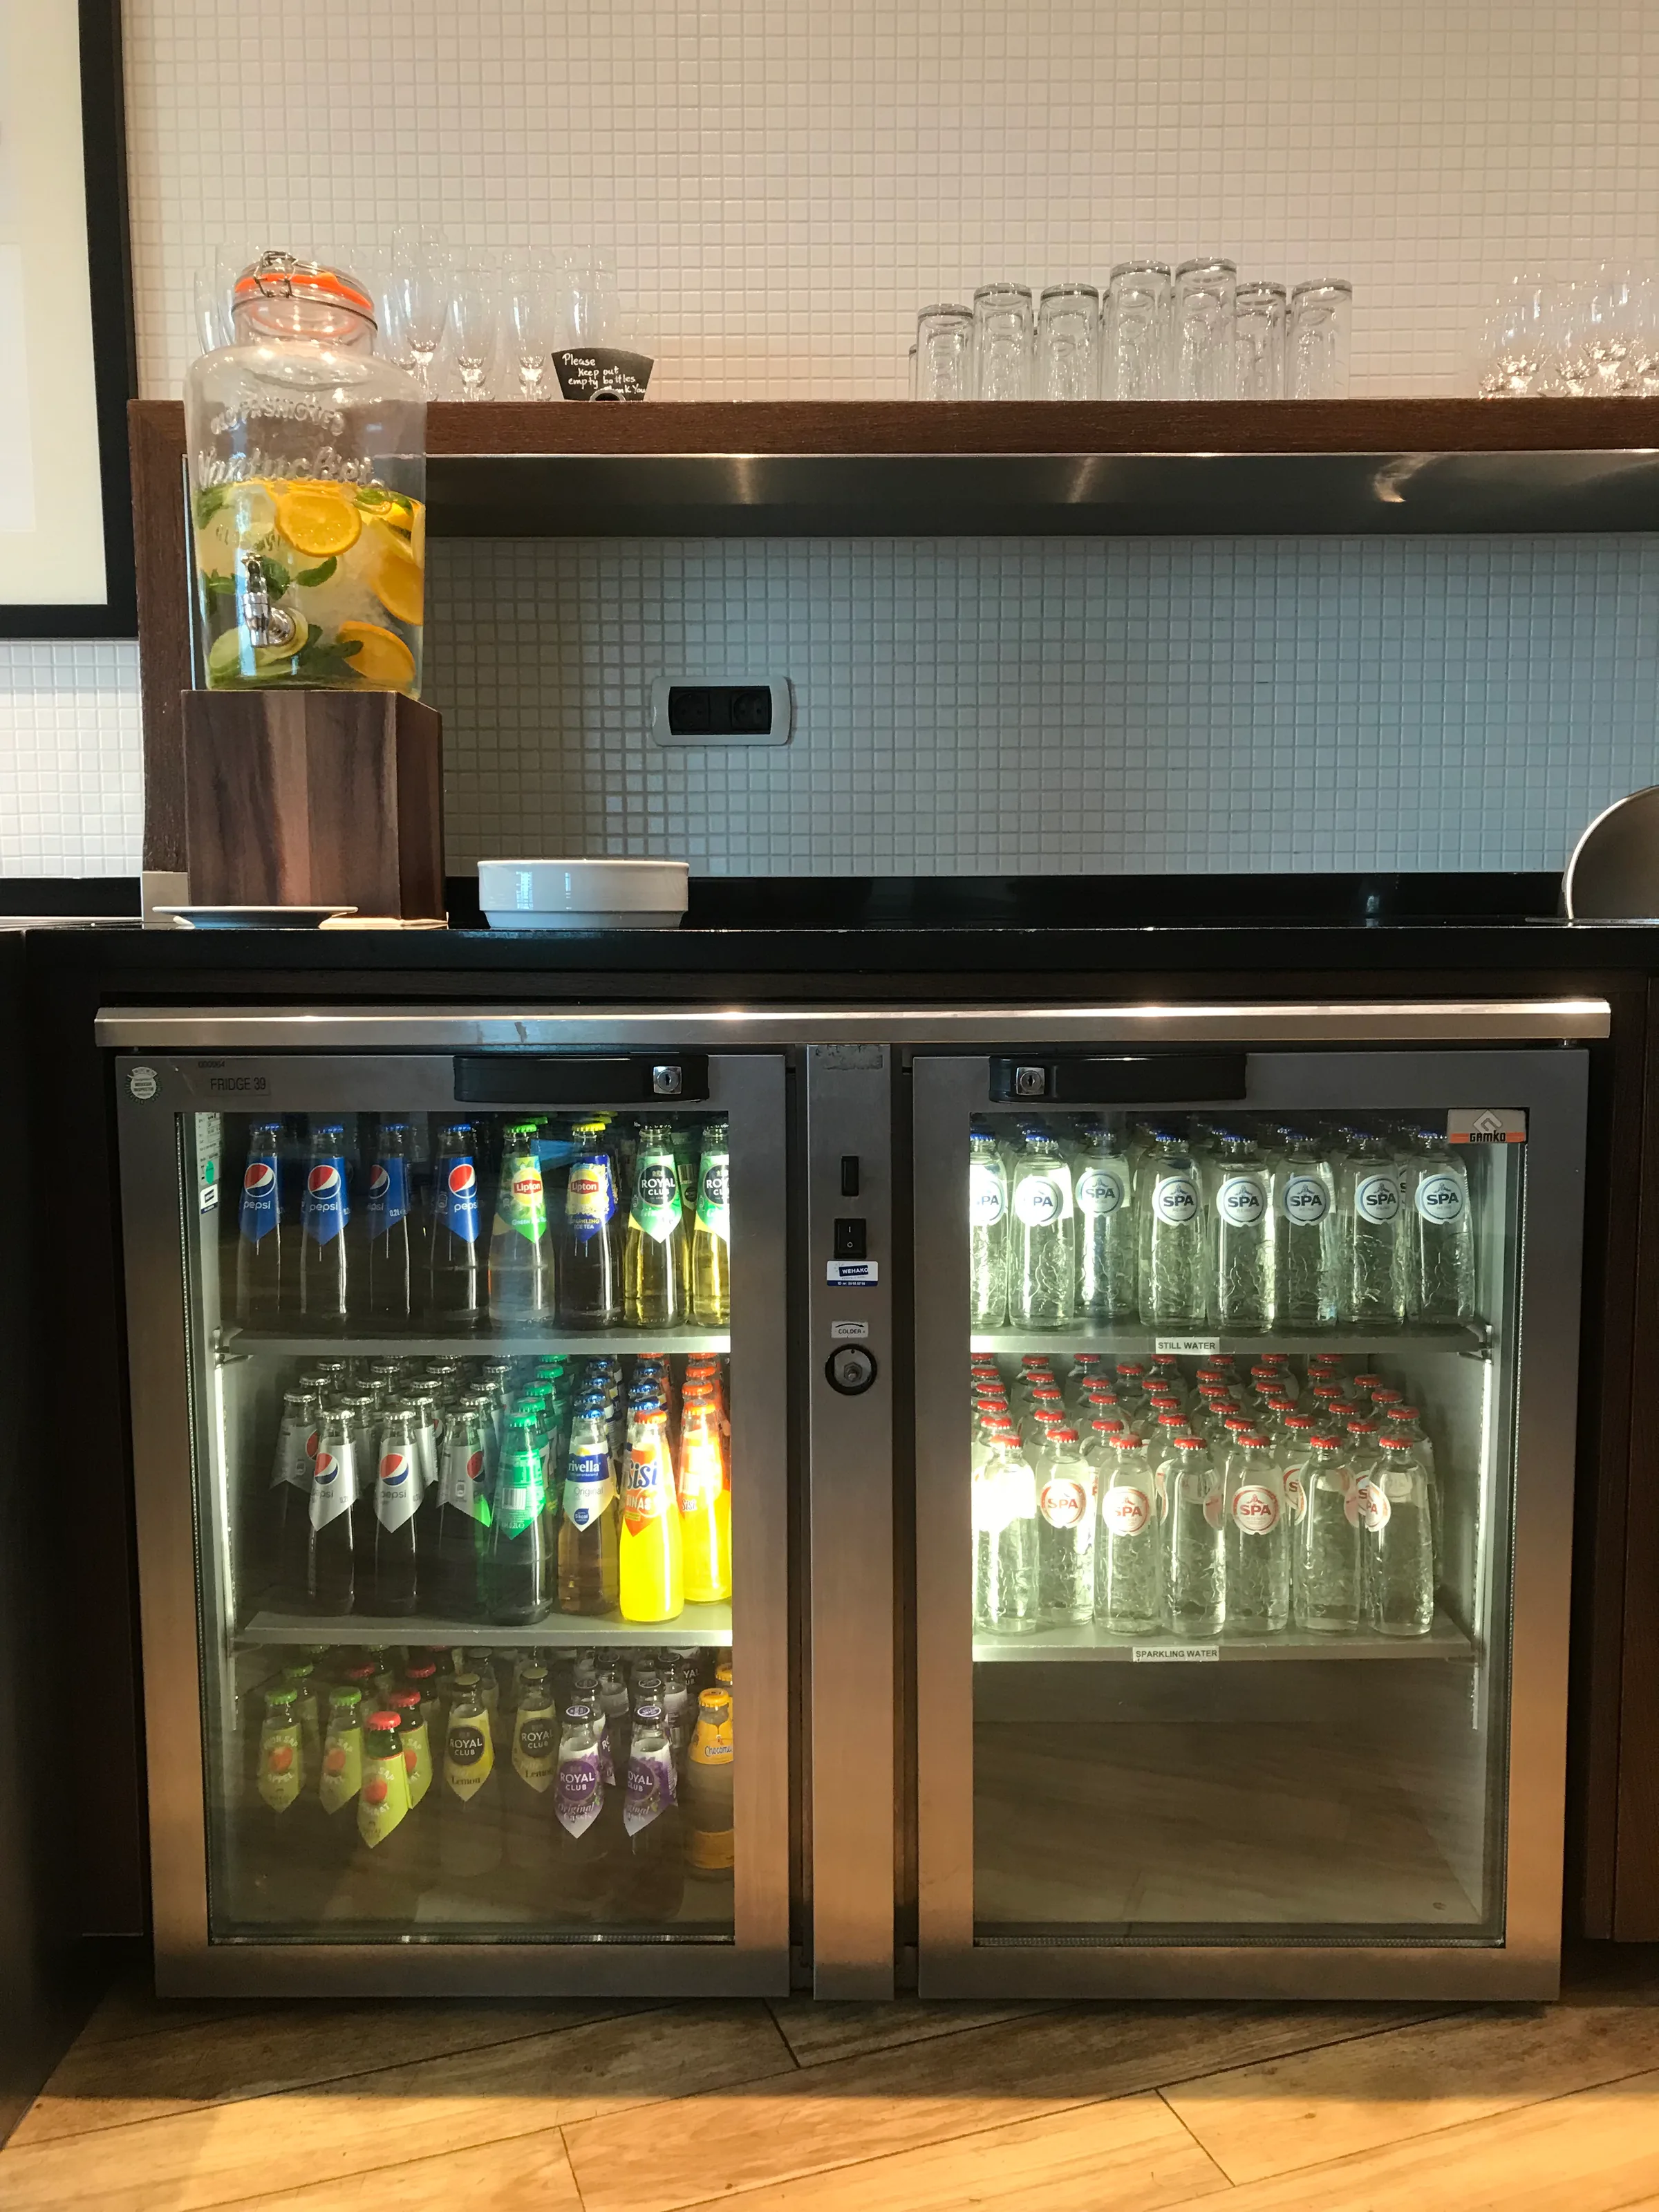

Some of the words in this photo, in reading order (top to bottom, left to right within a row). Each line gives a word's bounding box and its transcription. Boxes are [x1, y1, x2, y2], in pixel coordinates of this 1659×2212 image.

[561, 353, 596, 366] Please
[603, 366, 619, 375] out
[568, 376, 599, 390] empty
[603, 373, 636, 384] bottles
[210, 1077, 251, 1091] FRIDGE
[254, 1077, 266, 1090] 39
[516, 1183, 541, 1193] Lipton
[572, 1183, 597, 1193] Lipton
[641, 1178, 675, 1188] ROYAL
[1085, 1188, 1116, 1199] SPA
[1426, 1192, 1459, 1206] SPA
[980, 1194, 1000, 1206] PA
[1033, 1196, 1053, 1207] PA
[1163, 1194, 1194, 1207] SPA
[1228, 1194, 1260, 1208] SPA
[1290, 1194, 1322, 1207] SPA
[1366, 1193, 1397, 1206] SPA
[243, 1201, 271, 1210] pepsi
[310, 1202, 338, 1212] pepsi
[568, 1460, 600, 1473] rivella
[574, 1487, 603, 1497] Original
[682, 1499, 696, 1511] Sisi
[1047, 1498, 1079, 1509] SPA
[1366, 1501, 1378, 1515] PA
[1239, 1504, 1272, 1516] SPA
[1186, 1649, 1217, 1658] WATER
[521, 1730, 553, 1741] ROYAL
[450, 1738, 483, 1749] ROYAL
[451, 1775, 481, 1785] Lemon
[560, 1772, 595, 1782] ROYAL
[627, 1770, 653, 1785] OYAL
[559, 1801, 595, 1816] Original
